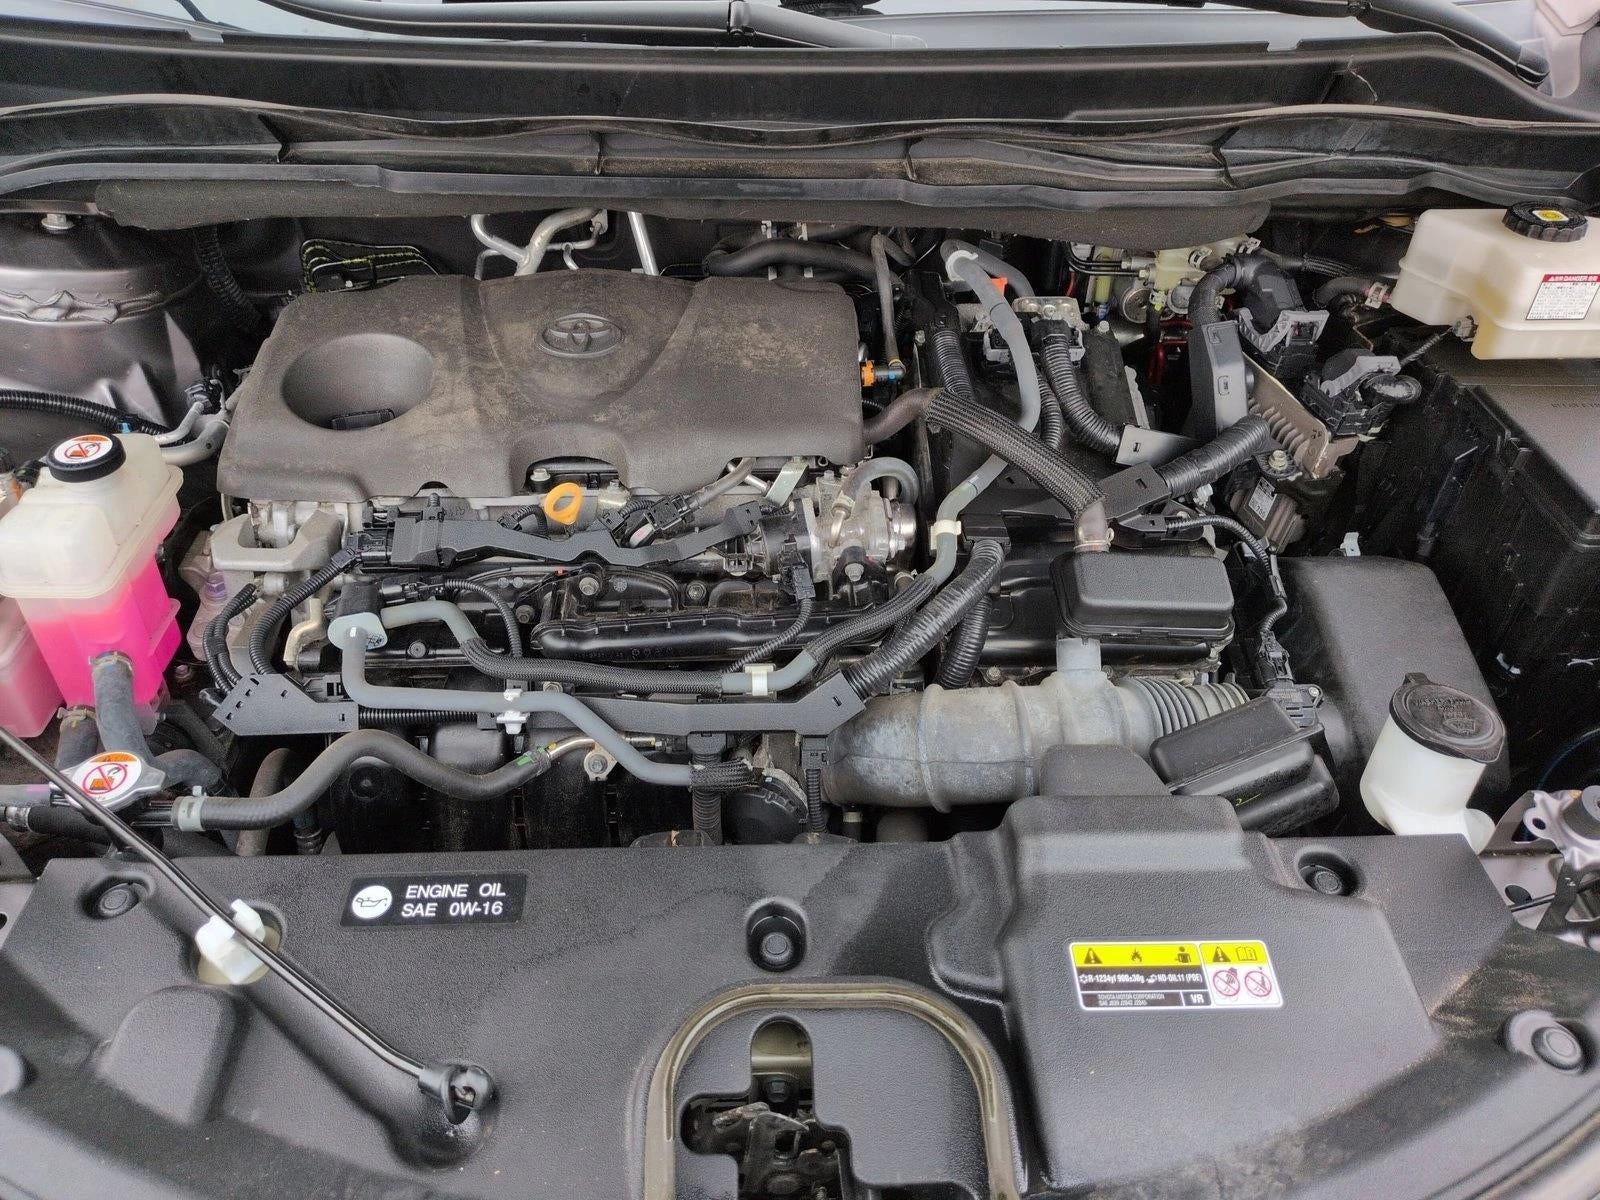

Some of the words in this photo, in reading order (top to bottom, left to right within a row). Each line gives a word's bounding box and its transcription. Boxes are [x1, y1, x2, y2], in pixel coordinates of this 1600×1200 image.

[405, 883, 469, 899] ENGINE
[479, 882, 506, 897] OIL
[401, 902, 438, 917] SAE
[449, 900, 503, 916] 0W-16
[1190, 993, 1204, 1004] VR
